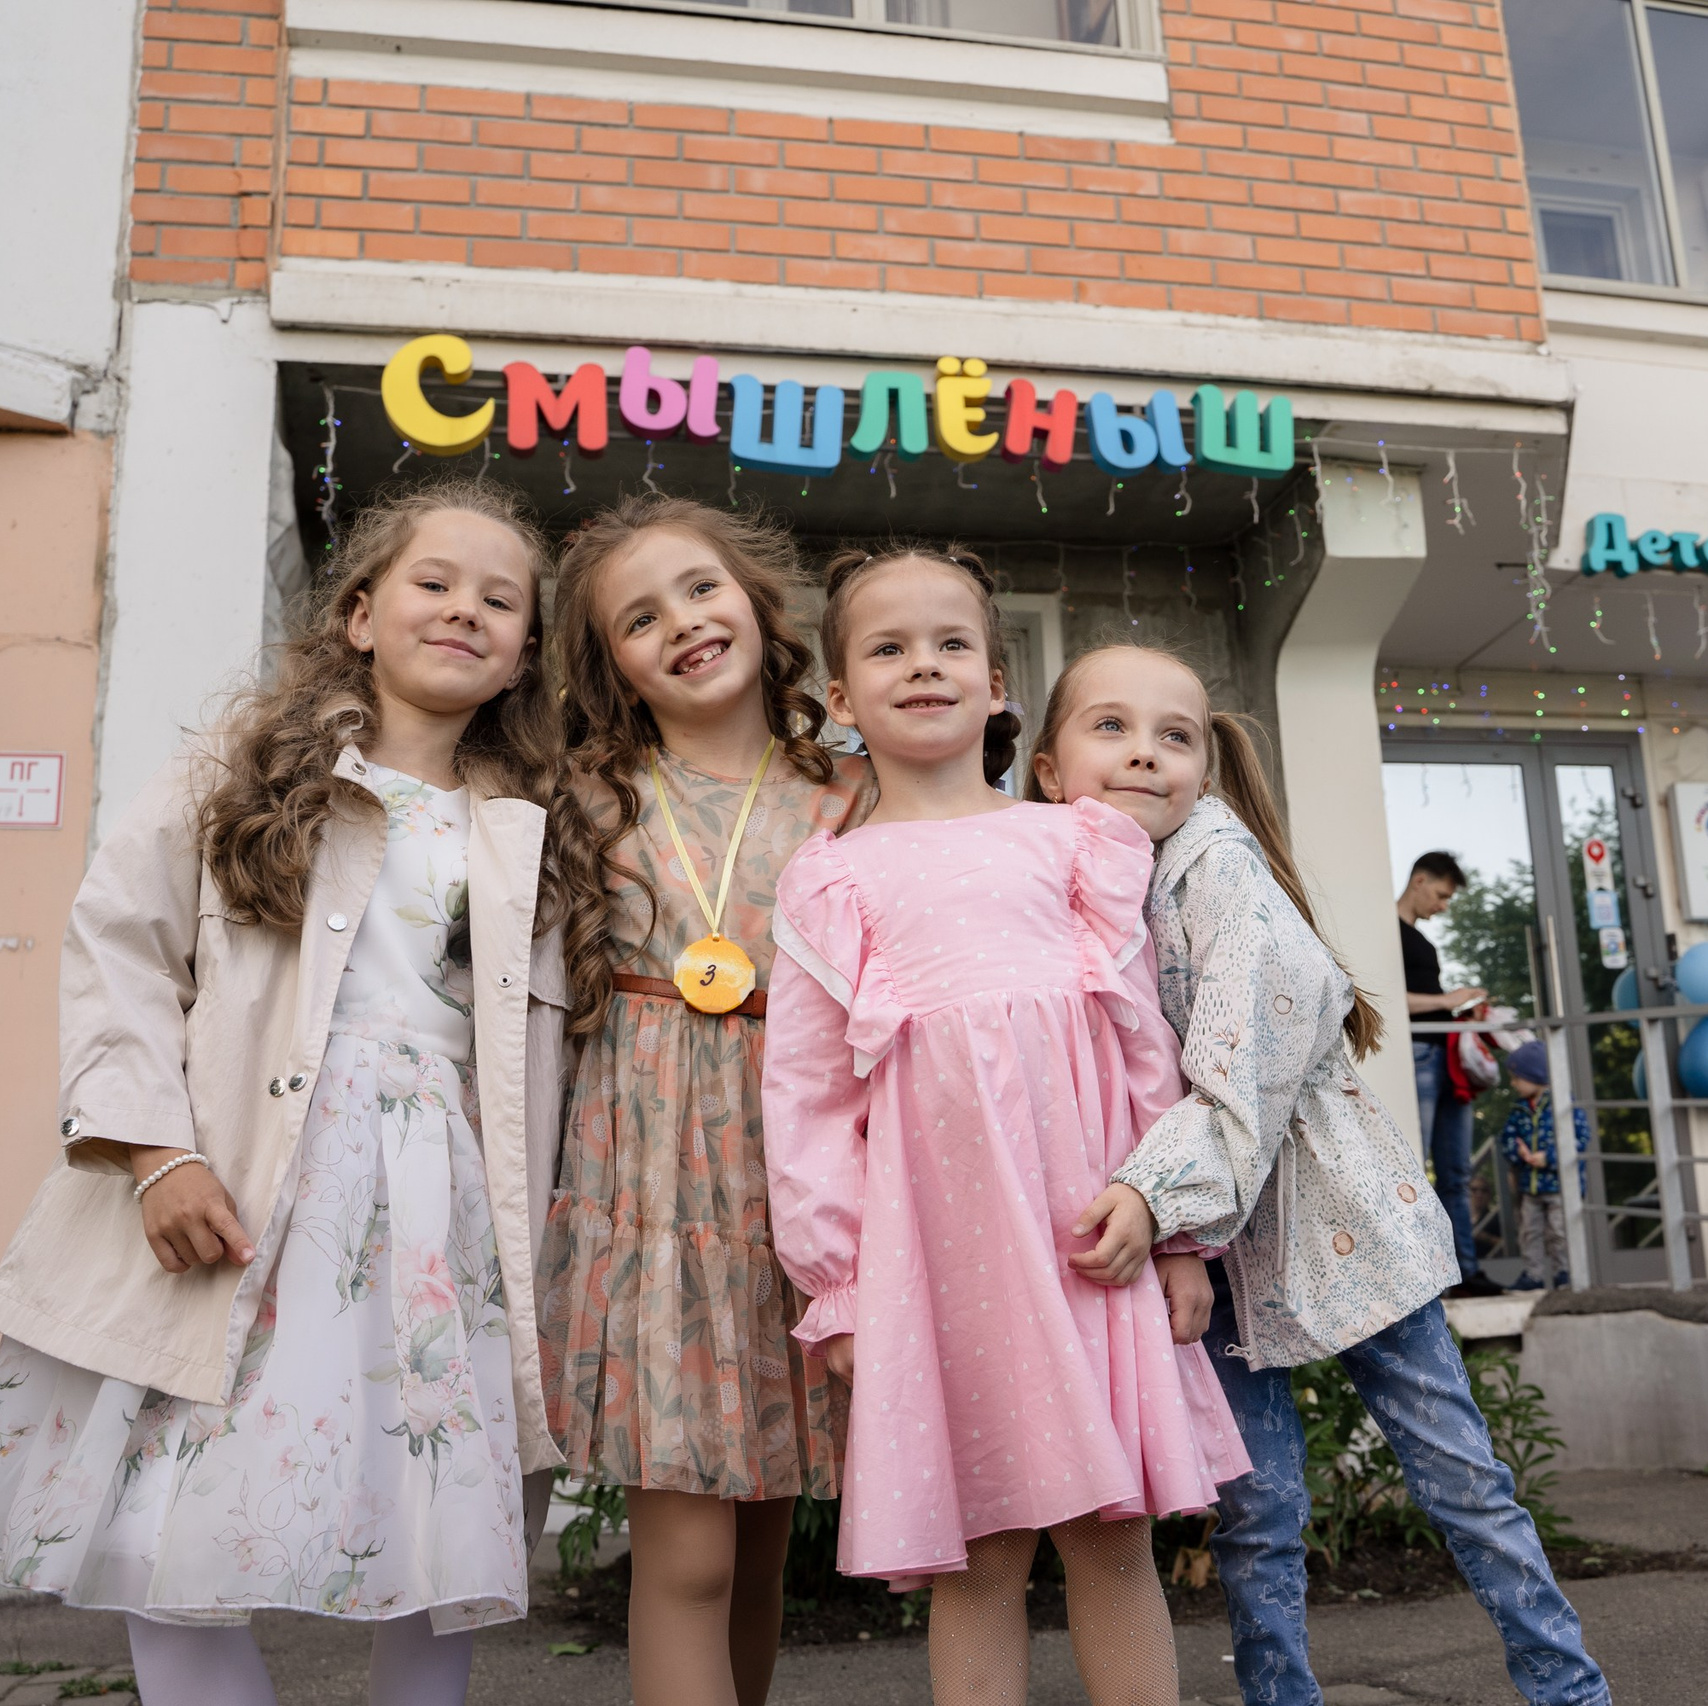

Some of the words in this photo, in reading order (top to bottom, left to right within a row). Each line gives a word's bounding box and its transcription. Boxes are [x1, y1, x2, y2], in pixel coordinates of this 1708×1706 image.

[1581, 512, 1708, 578] Дет
[10, 761, 39, 781] ПГ
[700, 964, 717, 986] 3
